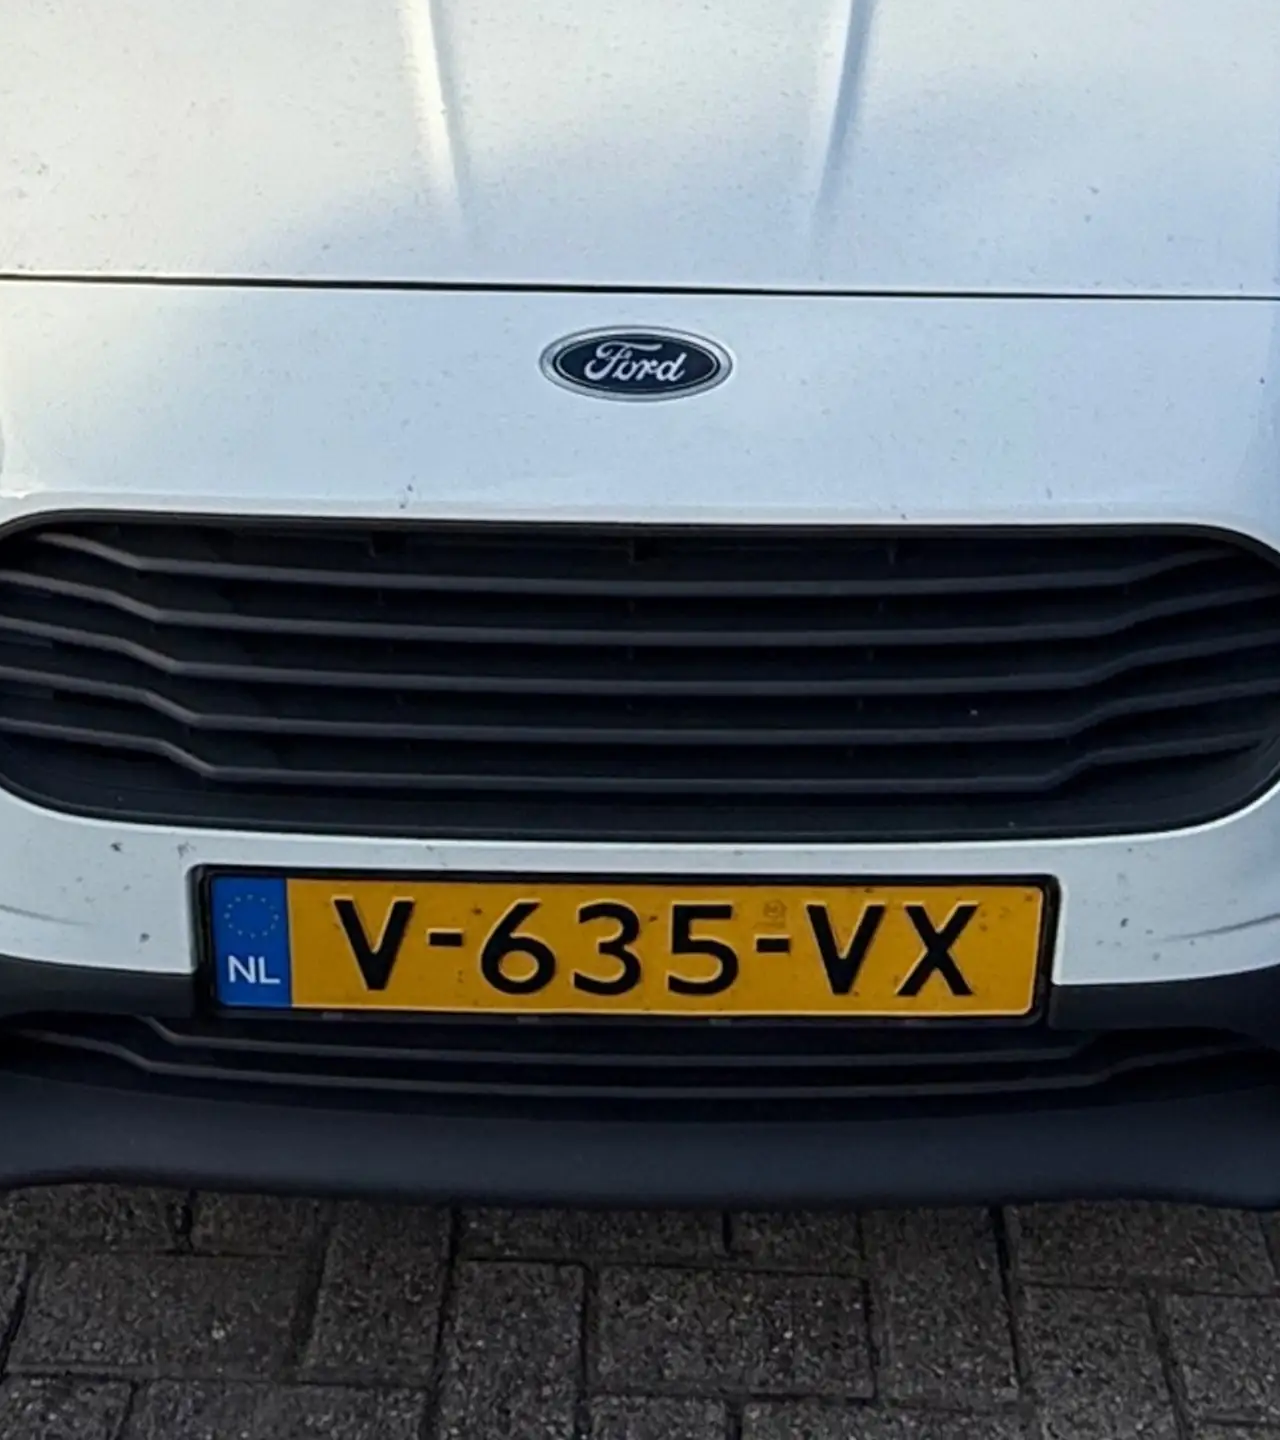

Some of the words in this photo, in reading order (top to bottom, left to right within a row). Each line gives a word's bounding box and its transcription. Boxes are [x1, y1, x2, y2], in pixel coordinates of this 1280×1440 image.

[584, 340, 688, 382] Ford
[333, 898, 979, 997] V-635-VX
[228, 955, 281, 984] NL
